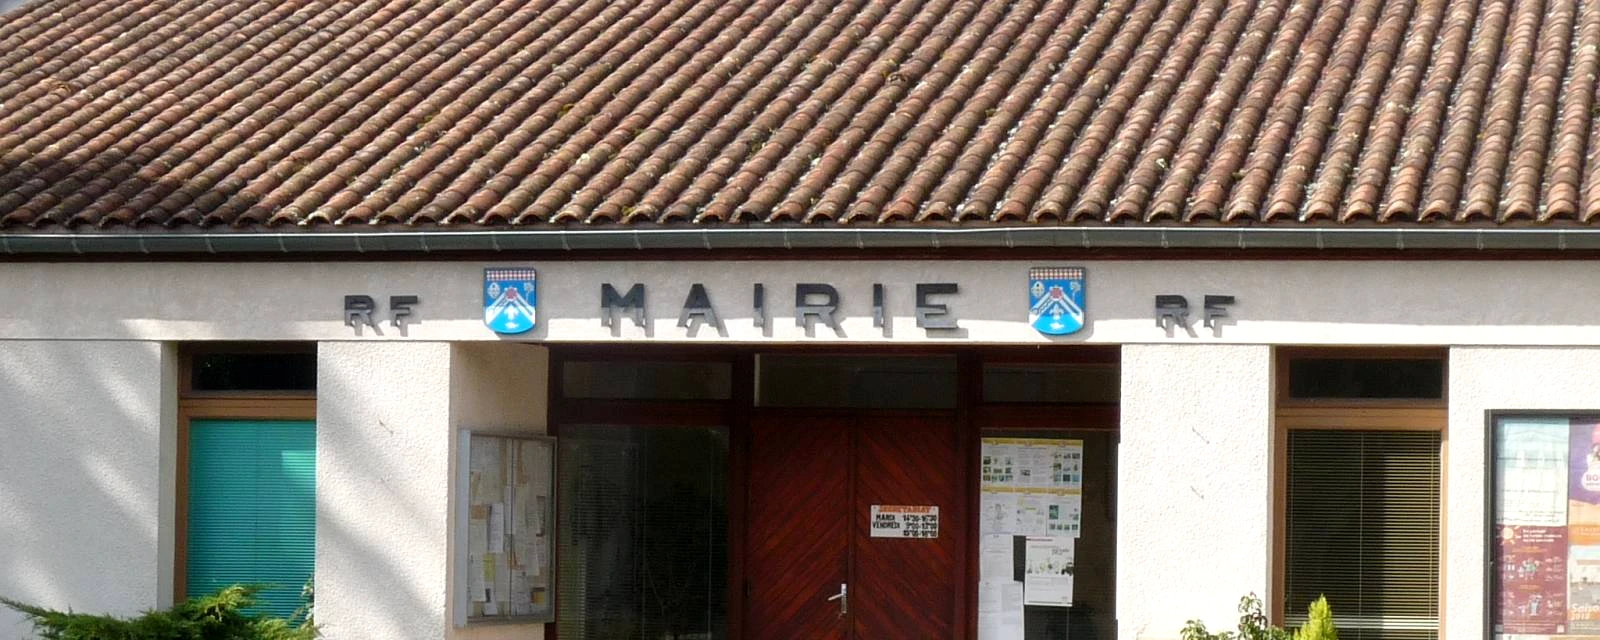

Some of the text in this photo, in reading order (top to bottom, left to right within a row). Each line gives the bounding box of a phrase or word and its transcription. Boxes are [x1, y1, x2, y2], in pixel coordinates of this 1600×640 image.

[344, 295, 418, 327] RF
[601, 283, 959, 329] MAIRIE
[1155, 295, 1236, 328] RF
